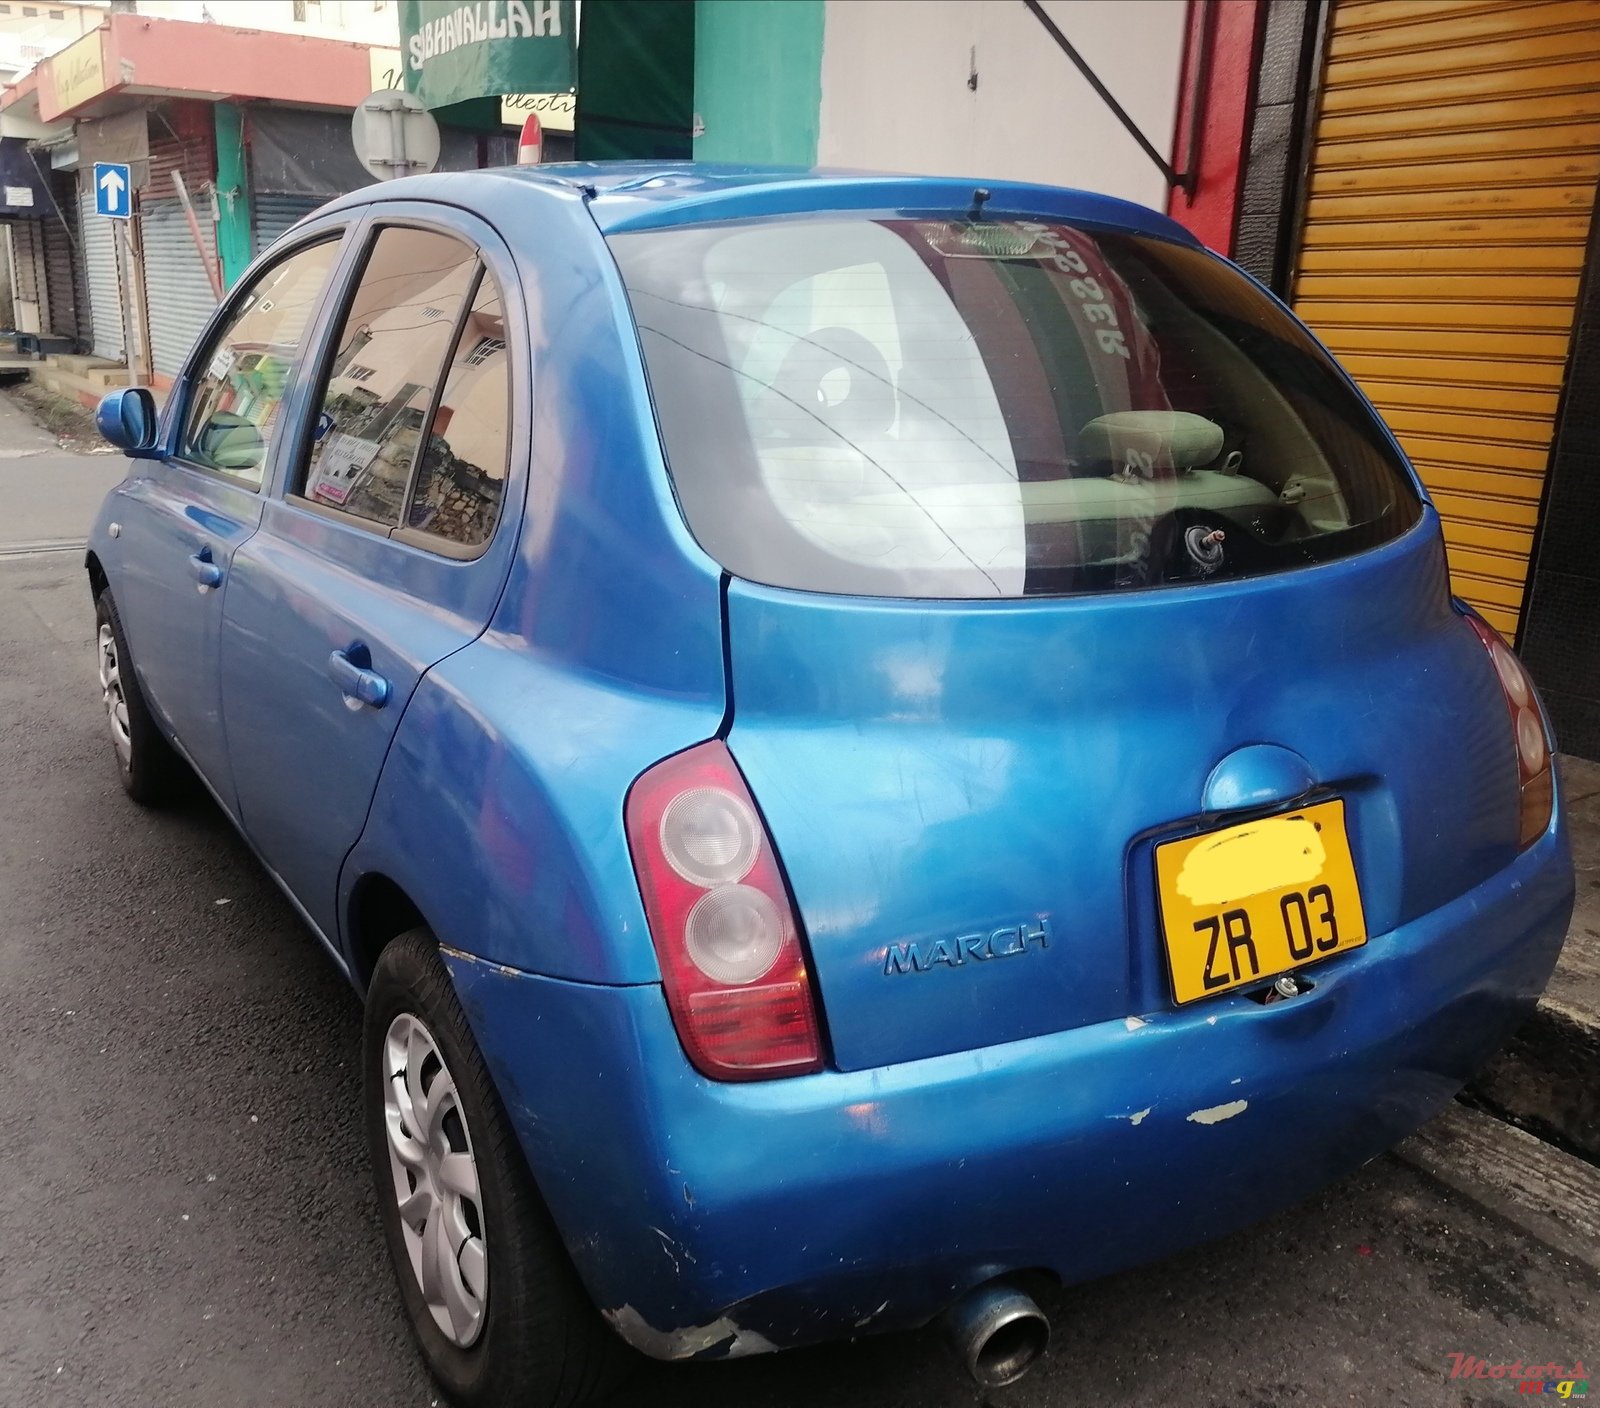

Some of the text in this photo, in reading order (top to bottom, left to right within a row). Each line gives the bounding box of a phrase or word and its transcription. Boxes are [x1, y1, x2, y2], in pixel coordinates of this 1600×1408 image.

[883, 919, 1049, 976] MARCH
[1193, 884, 1337, 990] ZR 03
